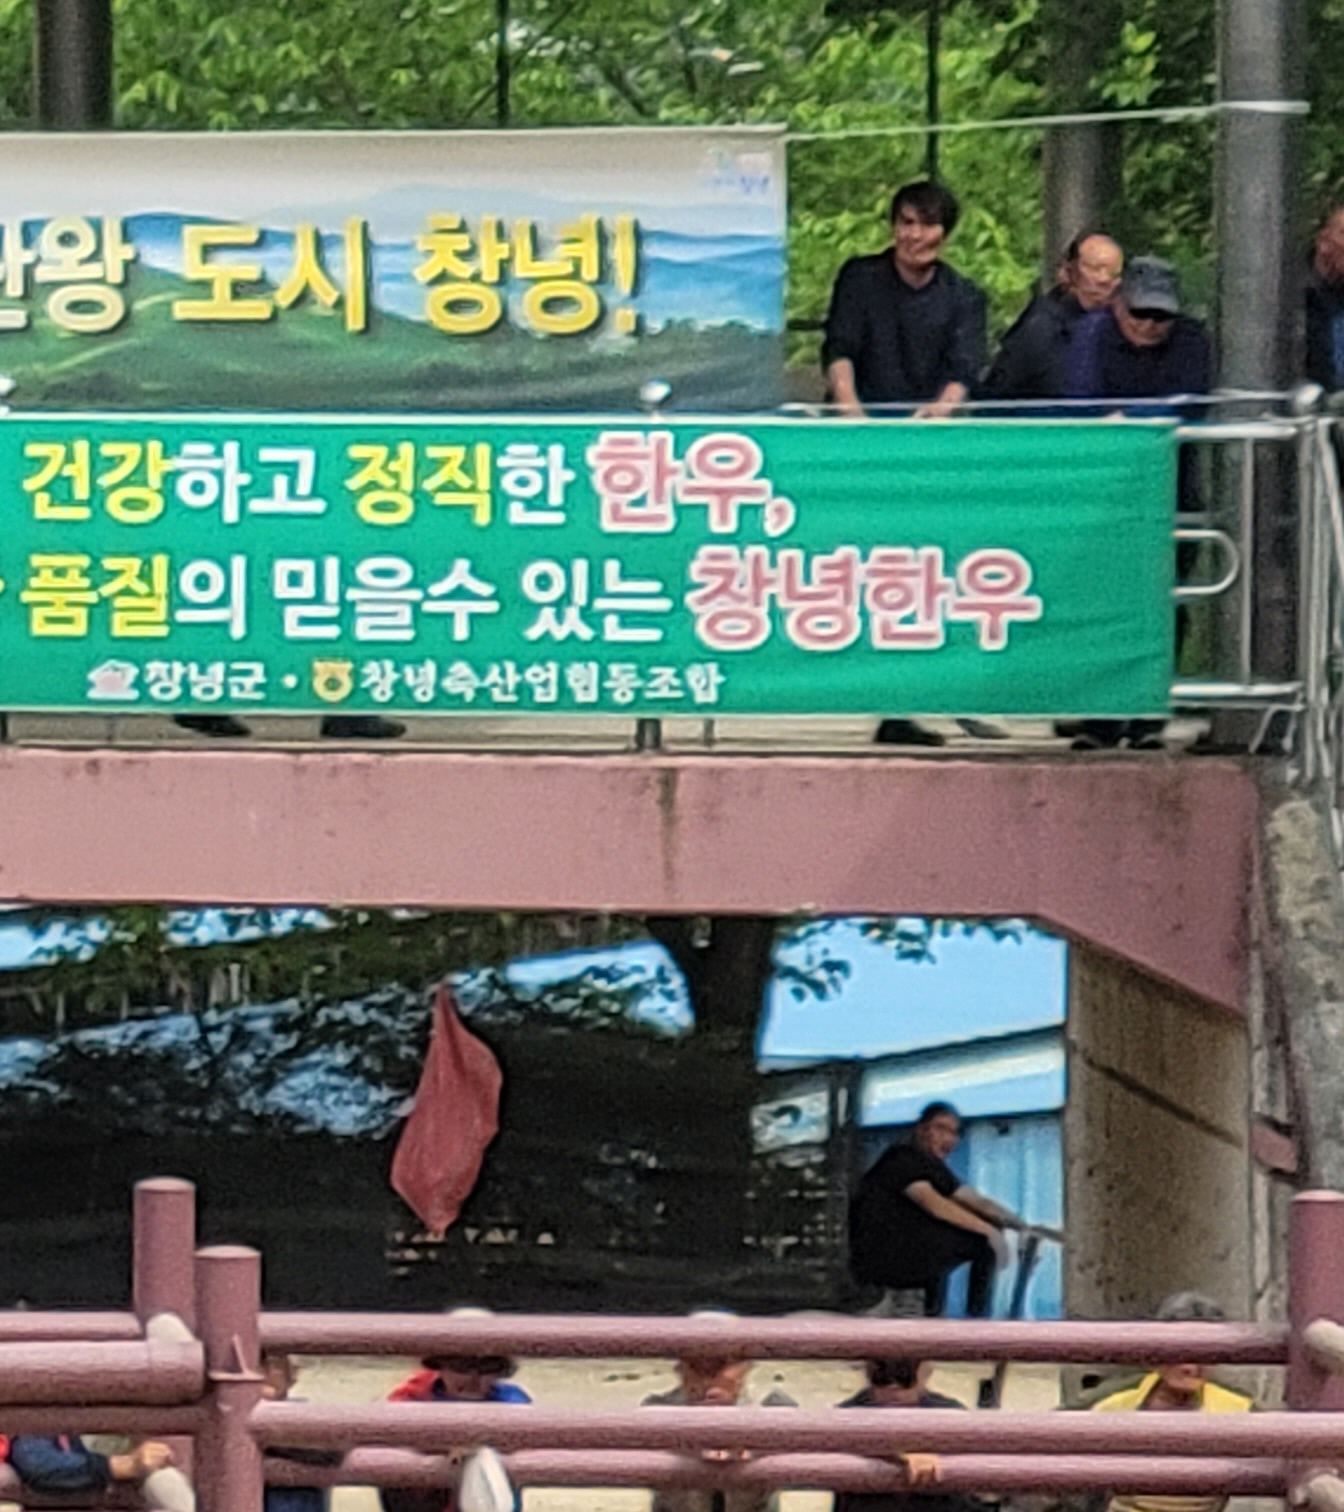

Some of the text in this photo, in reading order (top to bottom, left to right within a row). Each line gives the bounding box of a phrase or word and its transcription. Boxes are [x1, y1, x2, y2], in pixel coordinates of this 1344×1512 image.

[173, 216, 368, 333] 도시
[415, 212, 637, 335] 창녕!
[22, 431, 795, 536] 건강하고 정직한 한우,
[21, 553, 246, 639] 품질의
[271, 555, 498, 641] 믿을수
[523, 559, 672, 642] 있는
[686, 545, 1041, 650] 창녕한우
